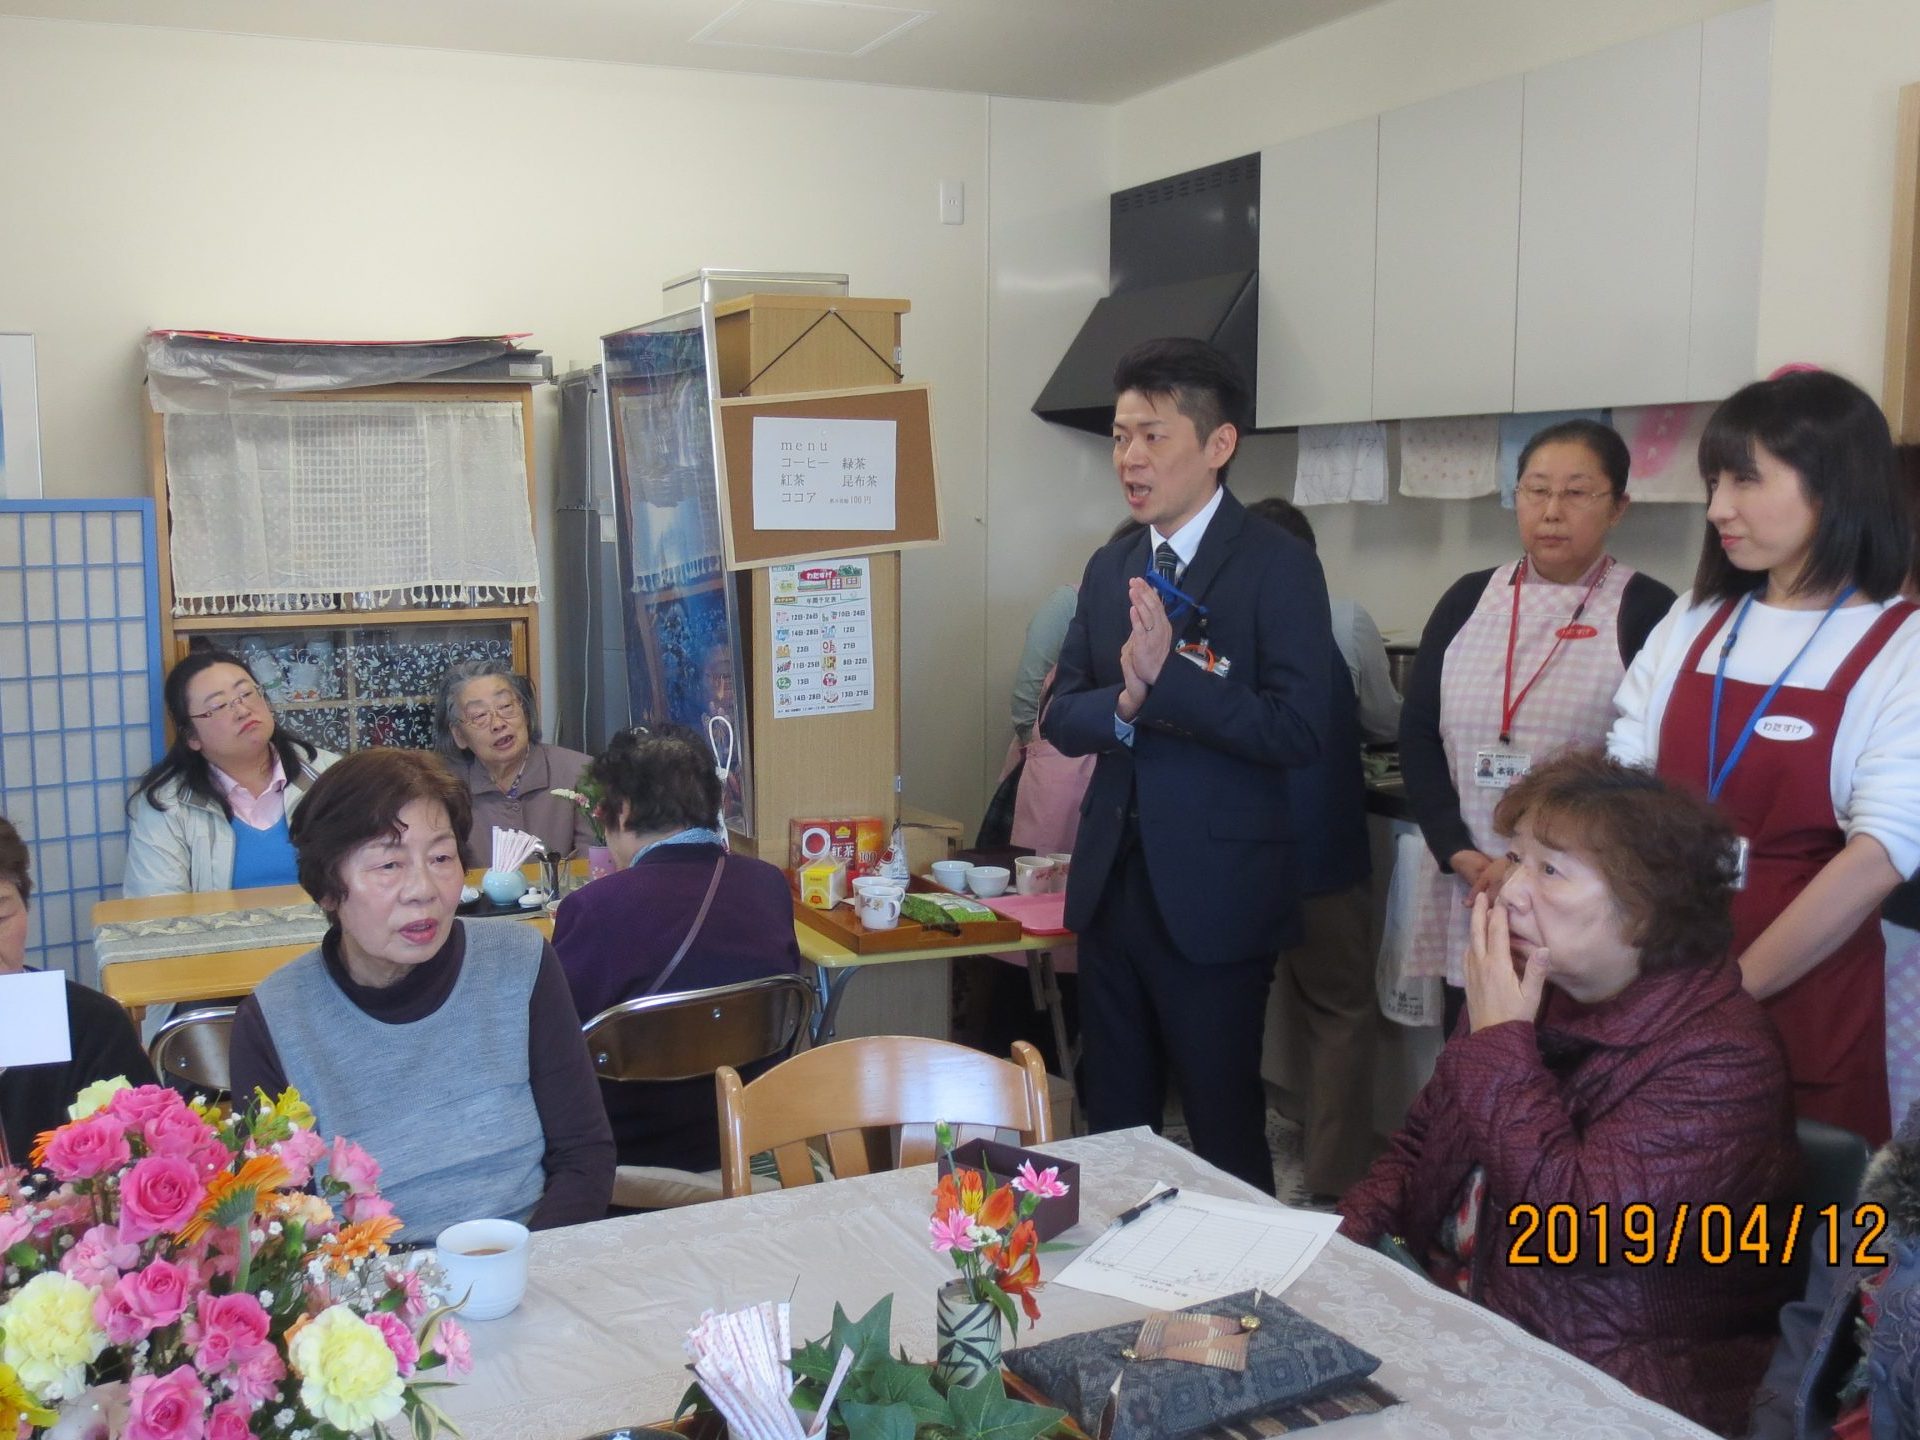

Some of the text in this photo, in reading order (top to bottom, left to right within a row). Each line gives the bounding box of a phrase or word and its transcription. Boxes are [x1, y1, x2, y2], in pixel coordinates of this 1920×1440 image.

[781, 442, 828, 451] menu
[781, 457, 866, 470] コーヒー 緑茶
[781, 474, 878, 488] 紅茶 昆布茶
[781, 492, 817, 504] ココア
[1763, 721, 1803, 734] わたすげ
[831, 845, 855, 858] 紅茶
